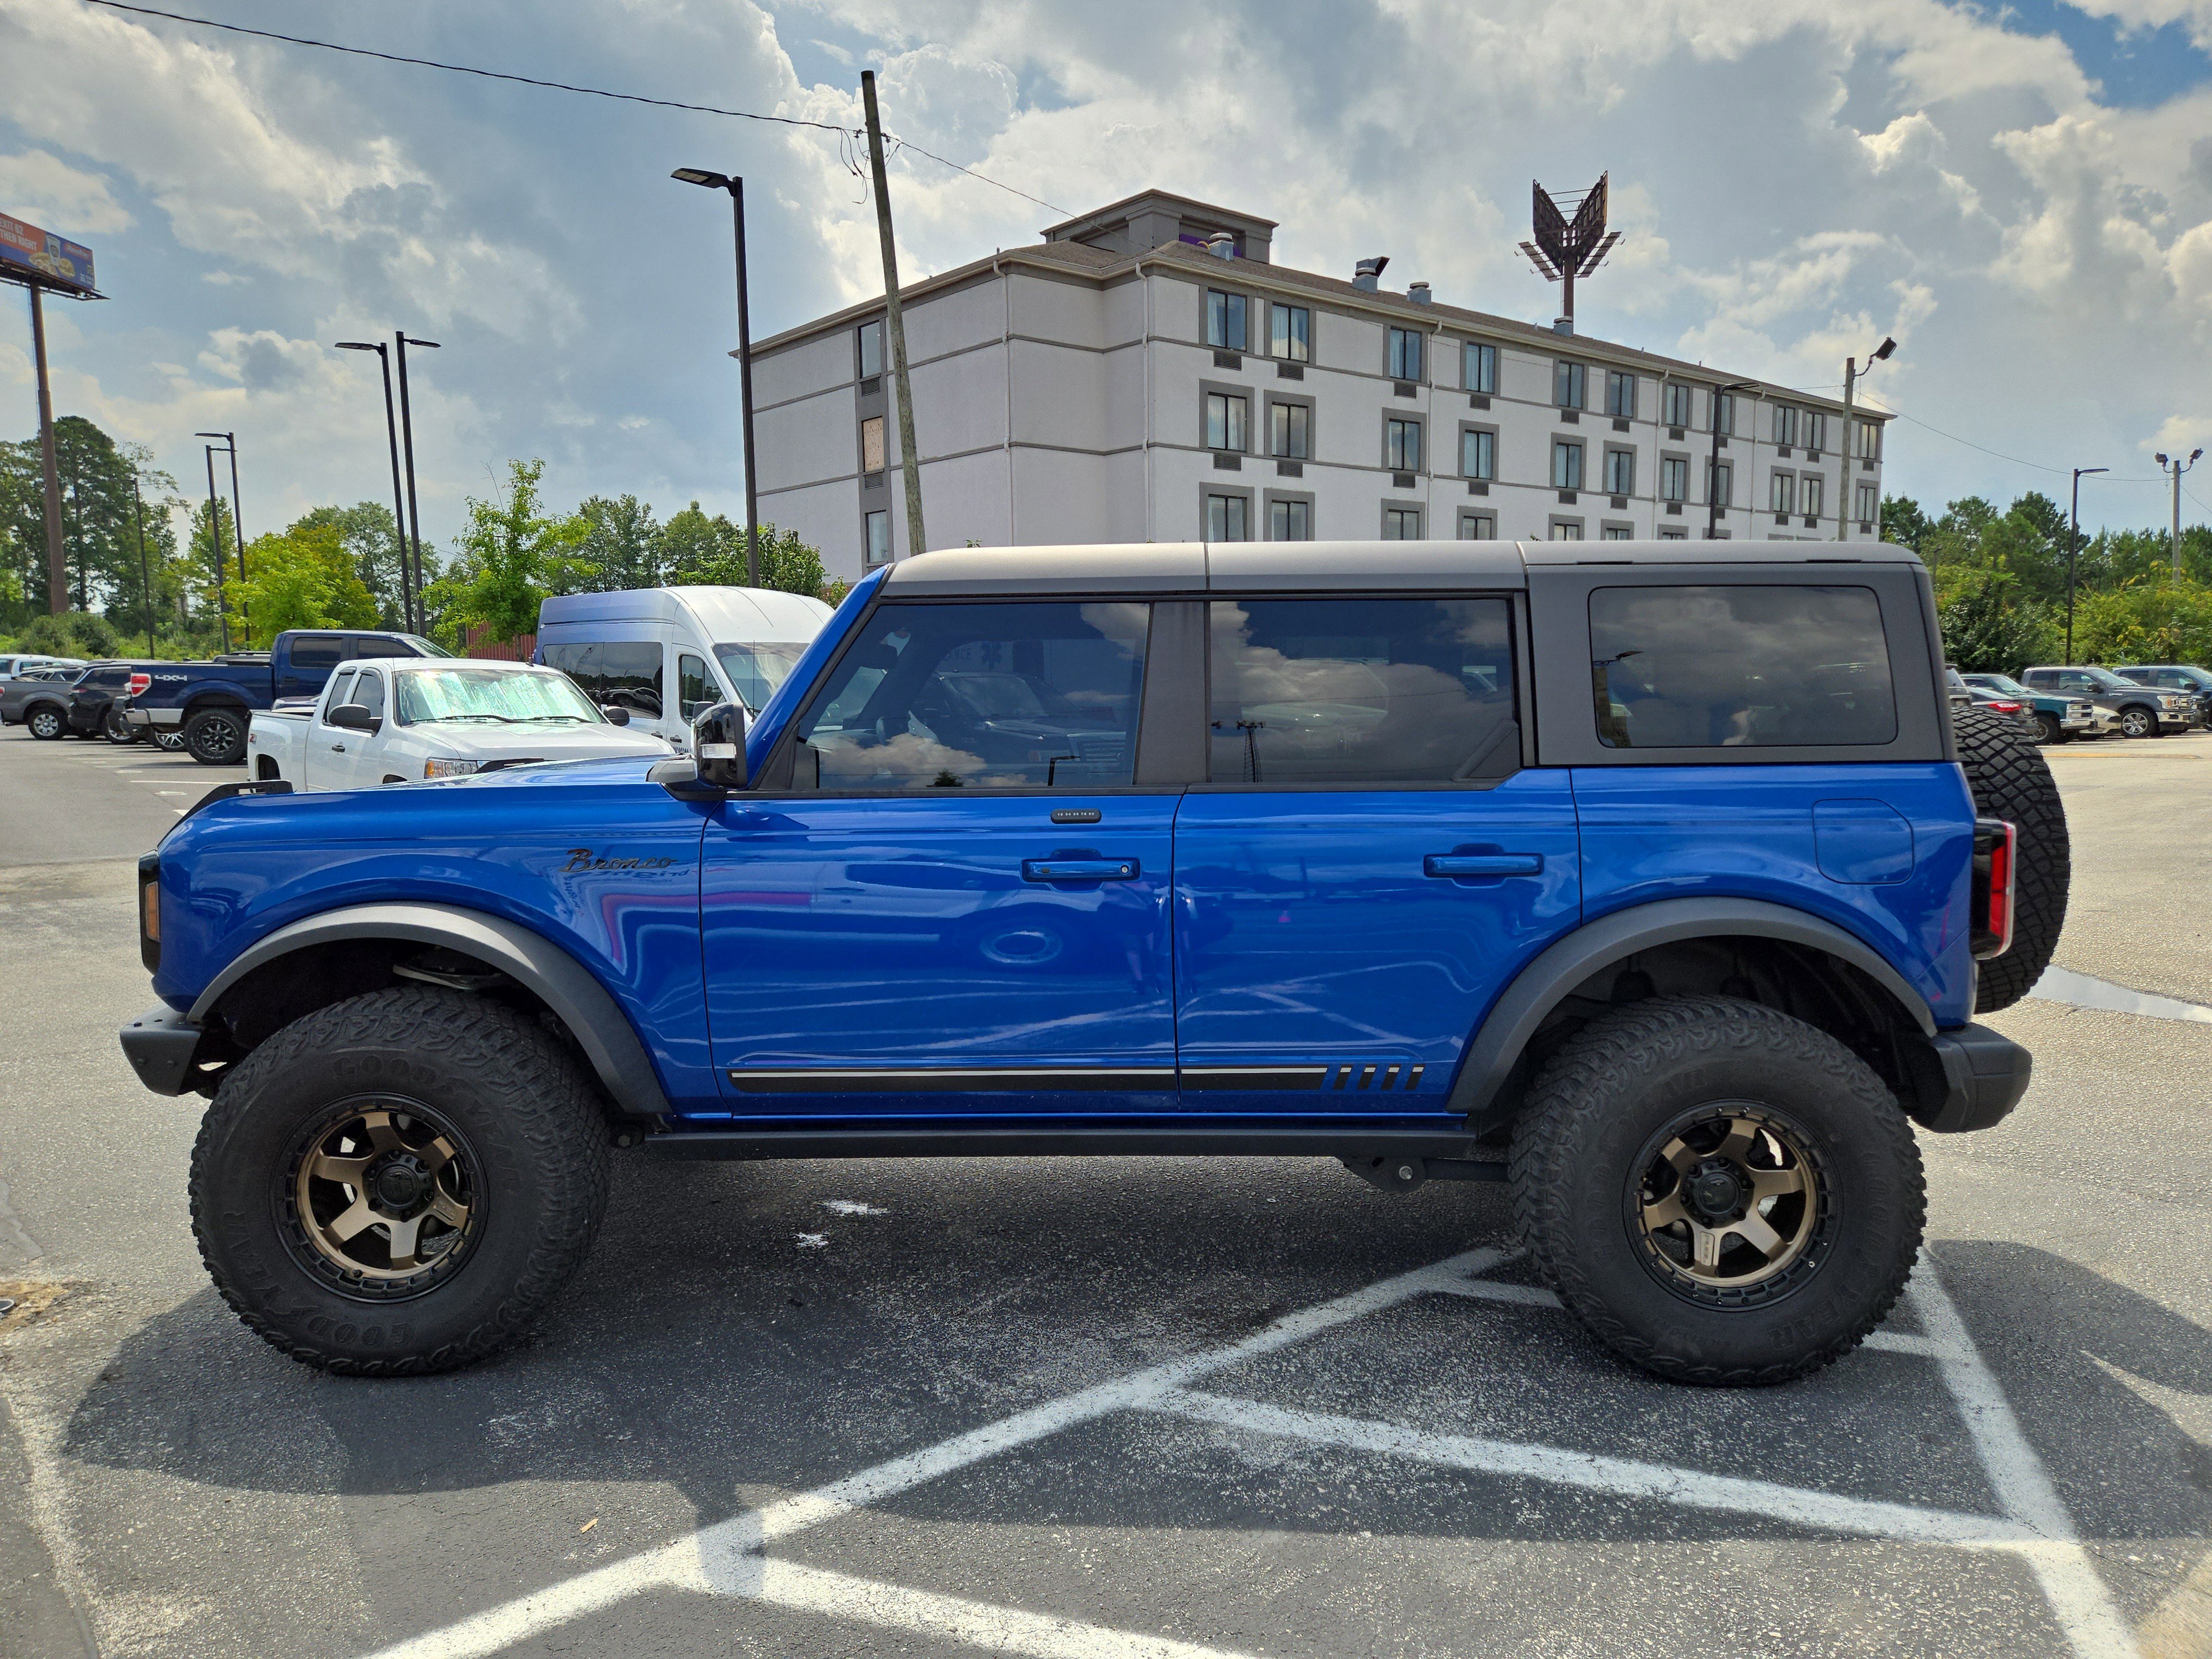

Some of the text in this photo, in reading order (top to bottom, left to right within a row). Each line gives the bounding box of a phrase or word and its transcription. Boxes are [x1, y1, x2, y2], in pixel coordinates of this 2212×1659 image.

[0, 228, 38, 251] THEN RIGHT
[558, 848, 678, 873] Bronco
